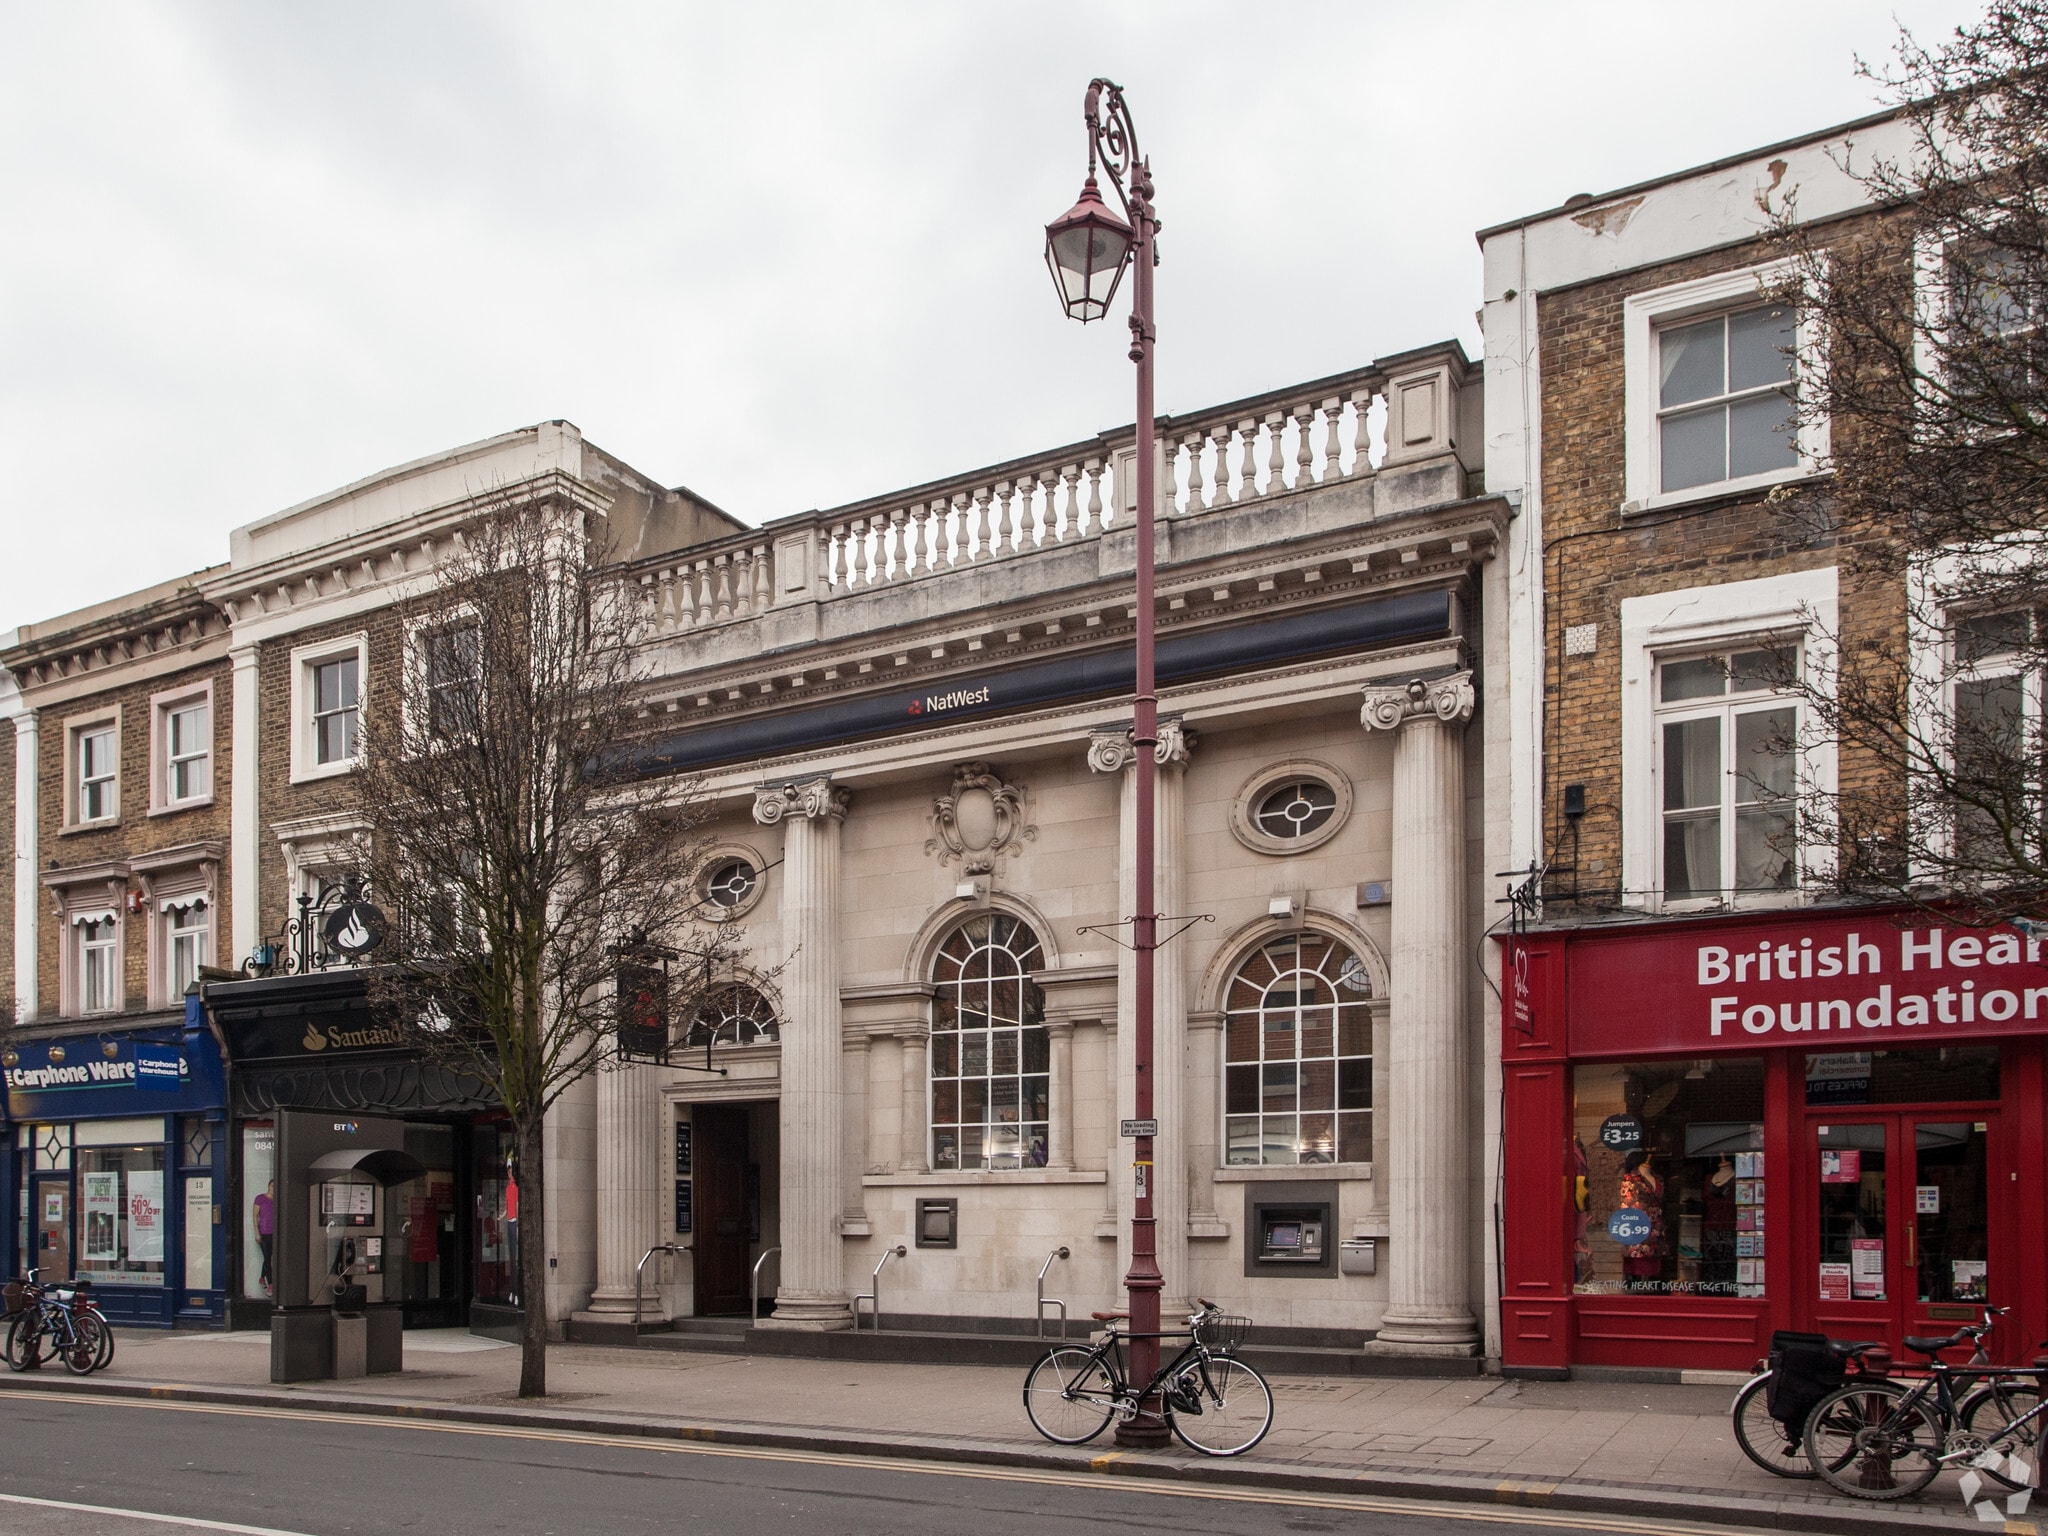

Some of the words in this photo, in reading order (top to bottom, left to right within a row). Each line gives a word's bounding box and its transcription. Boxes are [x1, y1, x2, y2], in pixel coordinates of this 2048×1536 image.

[926, 686, 989, 712] NatWest
[1698, 932, 1881, 985] British
[1711, 979, 2048, 1036] Foundation
[142, 1059, 178, 1069] Carphone
[4, 1069, 14, 1088] THE
[13, 1066, 89, 1088] Carphone
[87, 1057, 189, 1081] Waree
[139, 1067, 178, 1076] Warehouse
[334, 1123, 347, 1131] BT
[1603, 1129, 1640, 1144] £3.25
[195, 1181, 204, 1189] 13
[131, 1199, 153, 1216] 50%
[1611, 1223, 1650, 1237] £6.99
[1631, 1280, 1661, 1291] HEART
[1661, 1281, 1694, 1292] DISEASE
[1698, 1281, 1741, 1293] TOGETHE
